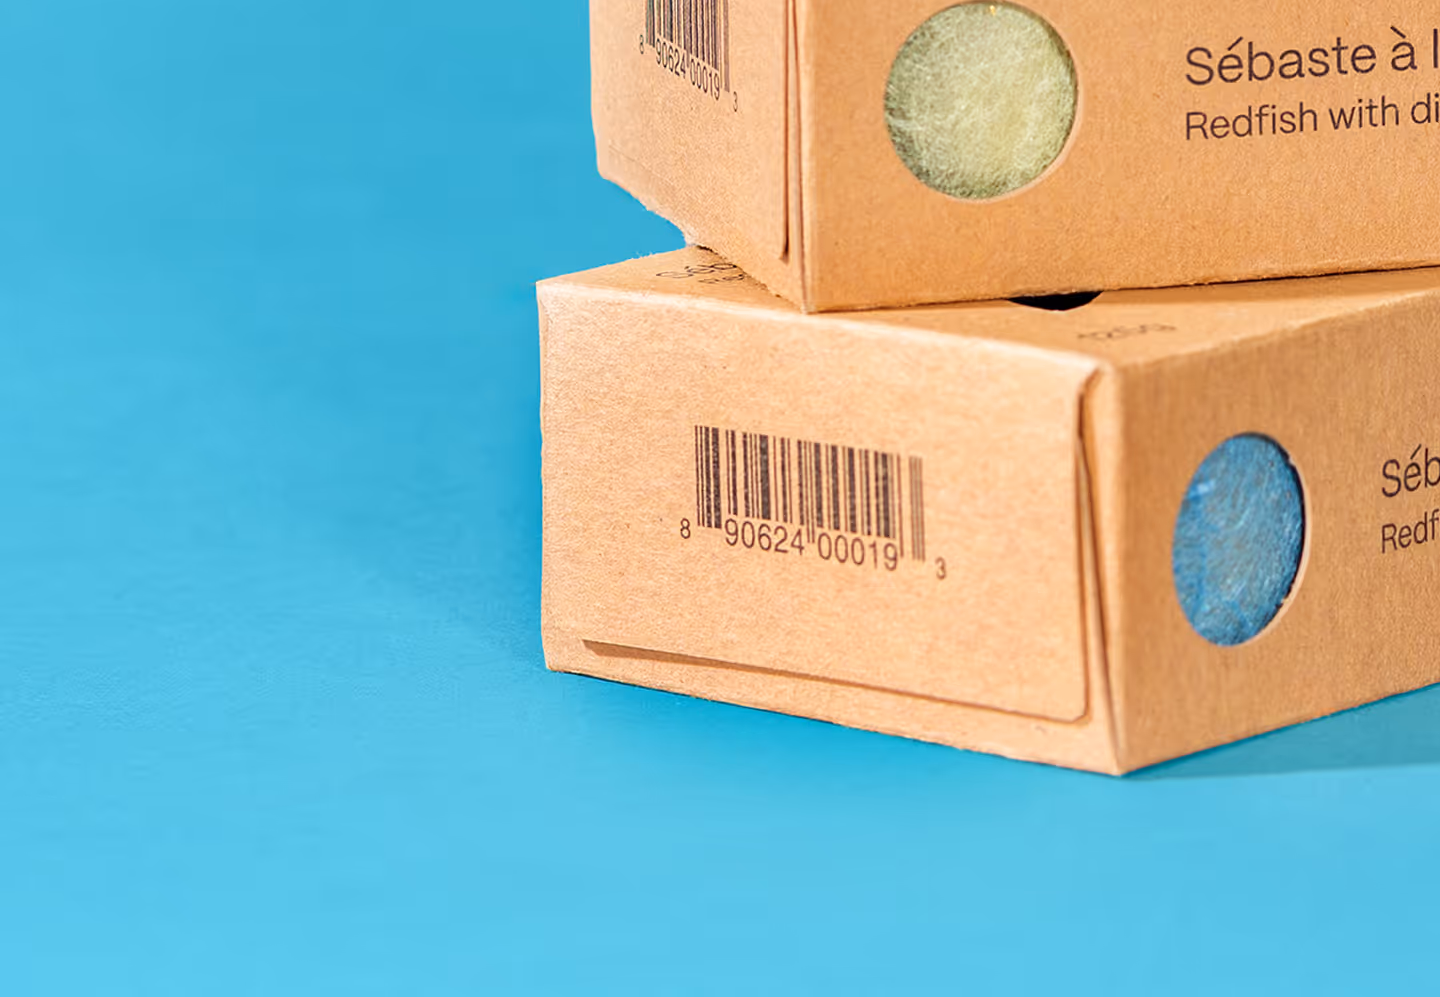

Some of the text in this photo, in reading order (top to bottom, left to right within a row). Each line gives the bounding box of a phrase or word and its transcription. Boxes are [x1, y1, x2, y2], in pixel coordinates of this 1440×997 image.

[655, 38, 687, 80] 90624
[689, 57, 721, 101] 00019
[732, 90, 739, 113] 3
[1186, 35, 1377, 86] Sébaste
[1390, 26, 1418, 72] à
[1186, 101, 1318, 141] Redfish
[1328, 94, 1400, 131] with
[679, 517, 947, 581] 8 90624 00019 3
